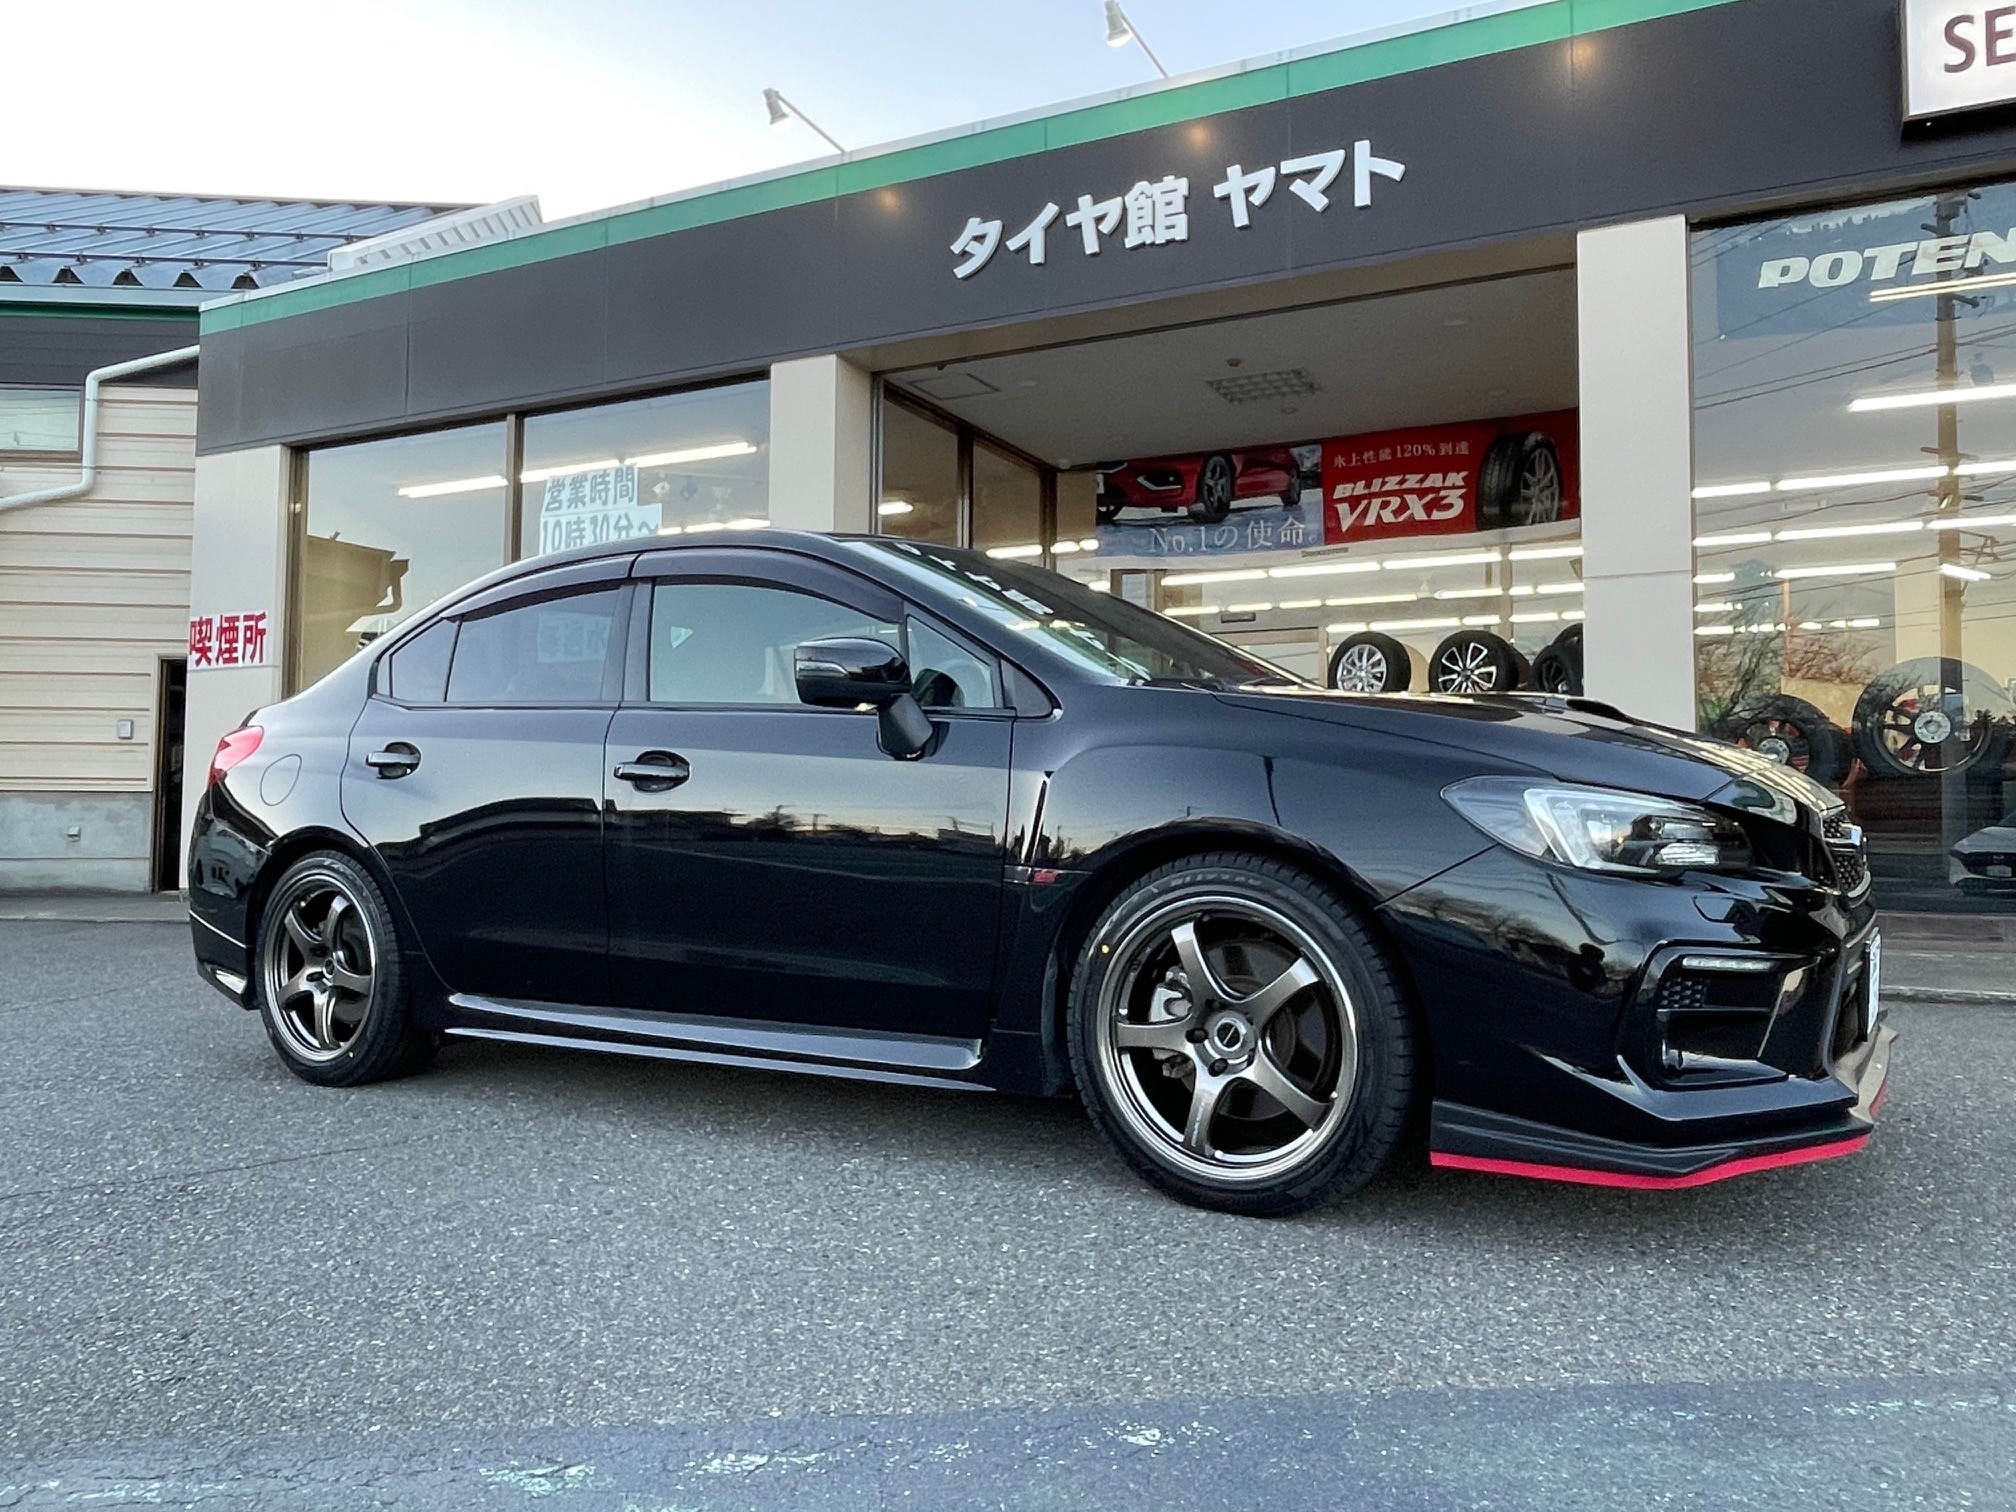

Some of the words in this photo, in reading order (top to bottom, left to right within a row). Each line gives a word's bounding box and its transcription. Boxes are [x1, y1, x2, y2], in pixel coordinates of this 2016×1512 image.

[1943, 7, 2016, 74] SE
[949, 174, 1189, 280] タイヤ館
[1212, 139, 1406, 228] ヤマト
[1758, 227, 2016, 290] POTEN
[545, 465, 636, 513] 営業時間
[1333, 471, 1469, 499] BLIZZAK
[1334, 488, 1467, 533] VRX3
[189, 611, 267, 668] 喫煙所
